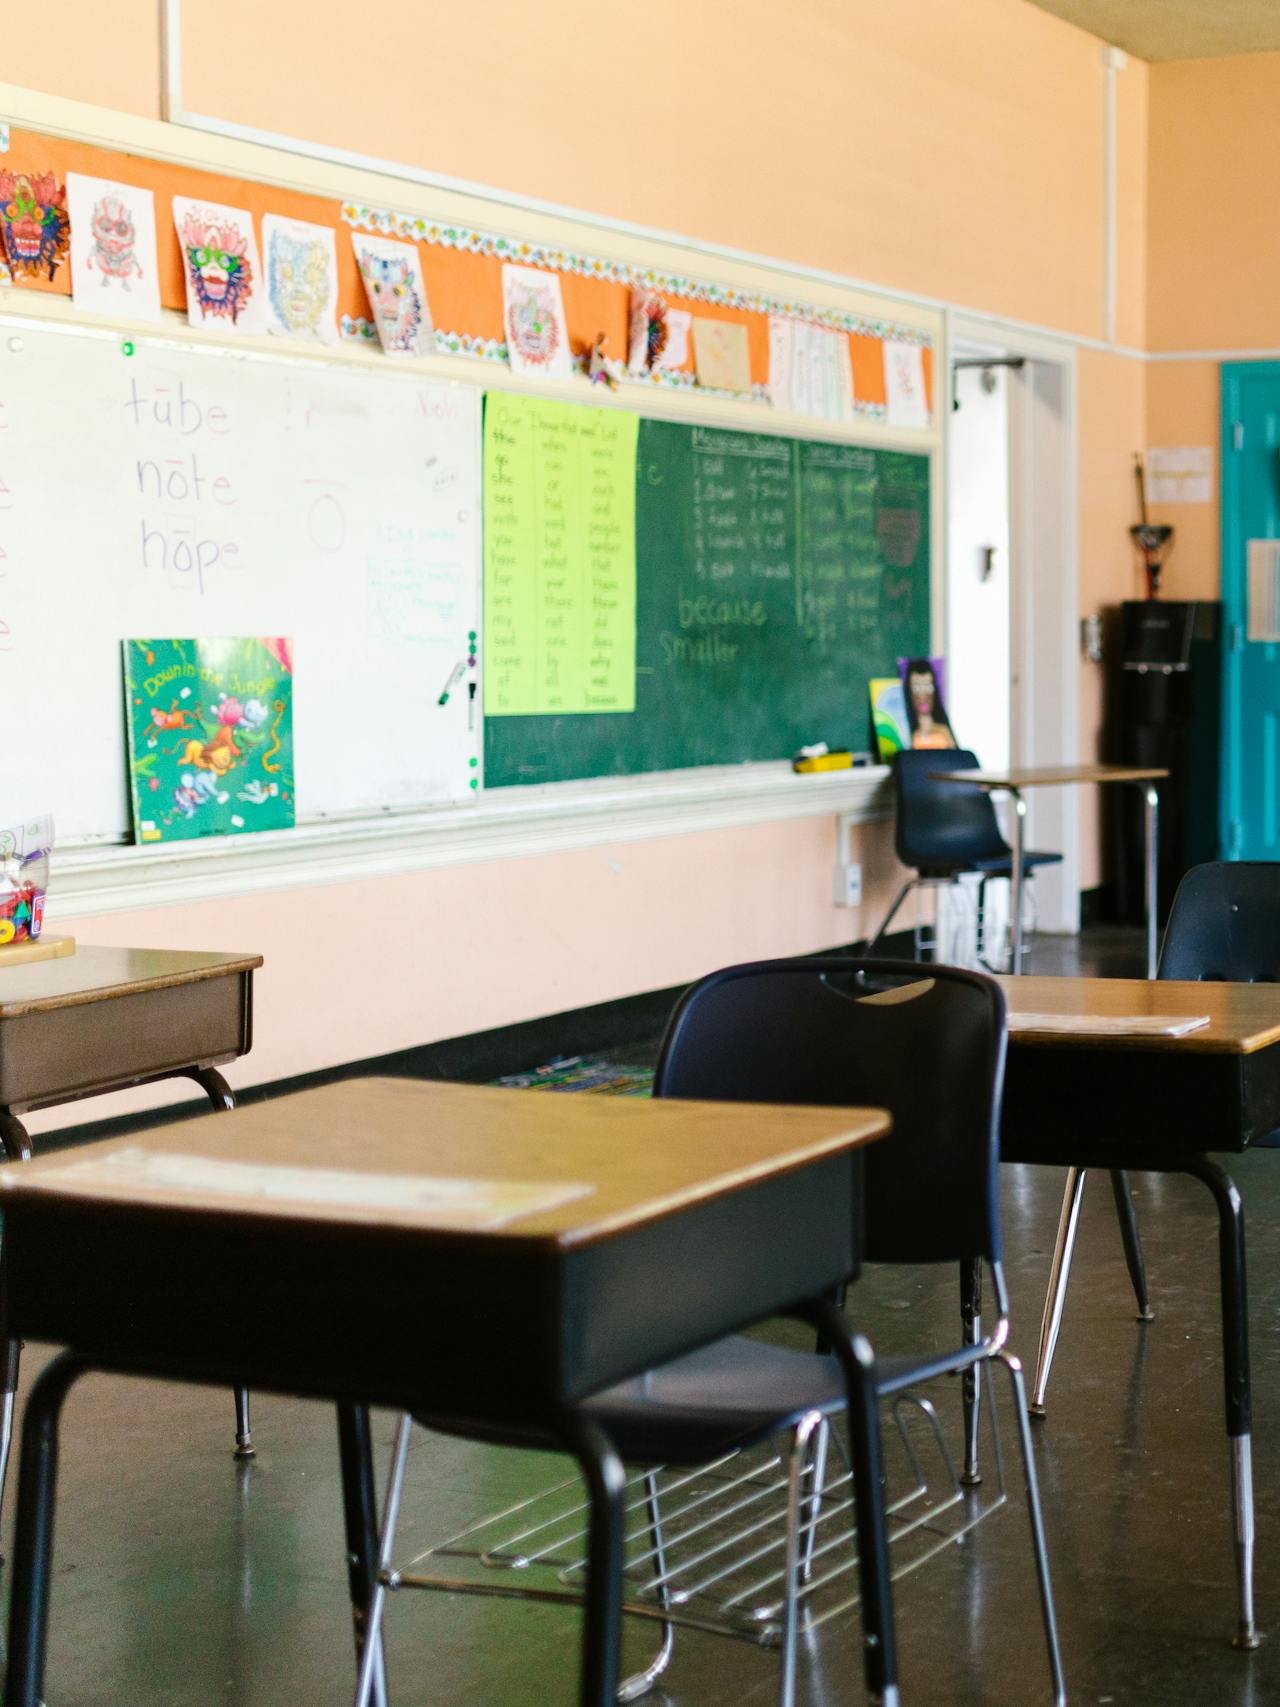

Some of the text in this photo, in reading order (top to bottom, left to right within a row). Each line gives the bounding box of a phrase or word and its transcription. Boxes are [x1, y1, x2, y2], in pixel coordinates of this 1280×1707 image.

[678, 583, 768, 629] because
[143, 664, 182, 697] Down
[183, 664, 196, 678] in
